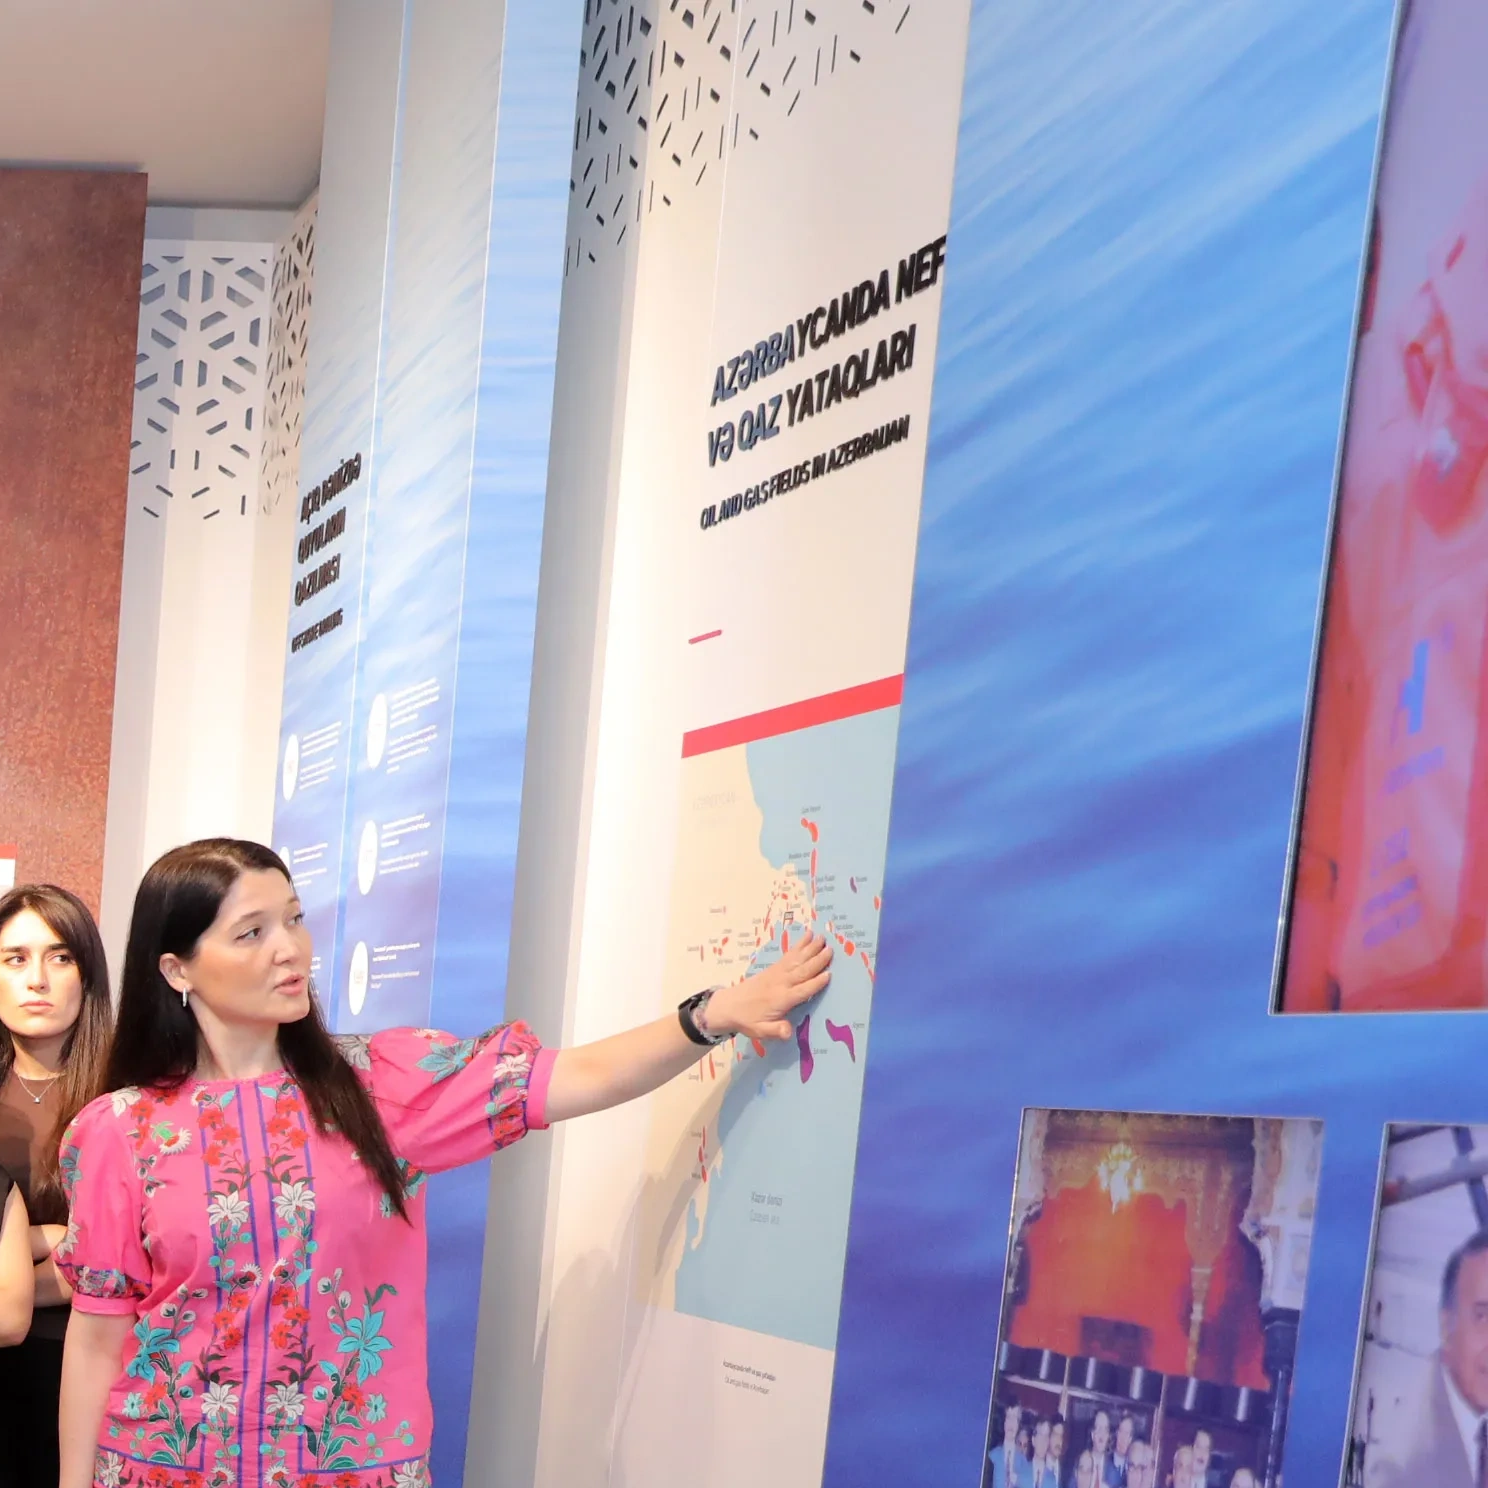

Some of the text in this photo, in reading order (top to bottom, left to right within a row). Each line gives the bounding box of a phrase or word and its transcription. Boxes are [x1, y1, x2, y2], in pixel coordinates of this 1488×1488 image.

[711, 234, 947, 407] AZƏRBAYCANDA NEF
[708, 324, 916, 467] VƏ QAZ YATAQLARI
[700, 504, 718, 530] OIL
[718, 493, 743, 522] AND
[743, 480, 768, 511] GAS
[769, 460, 811, 499] FIELDS
[811, 452, 826, 480] IN
